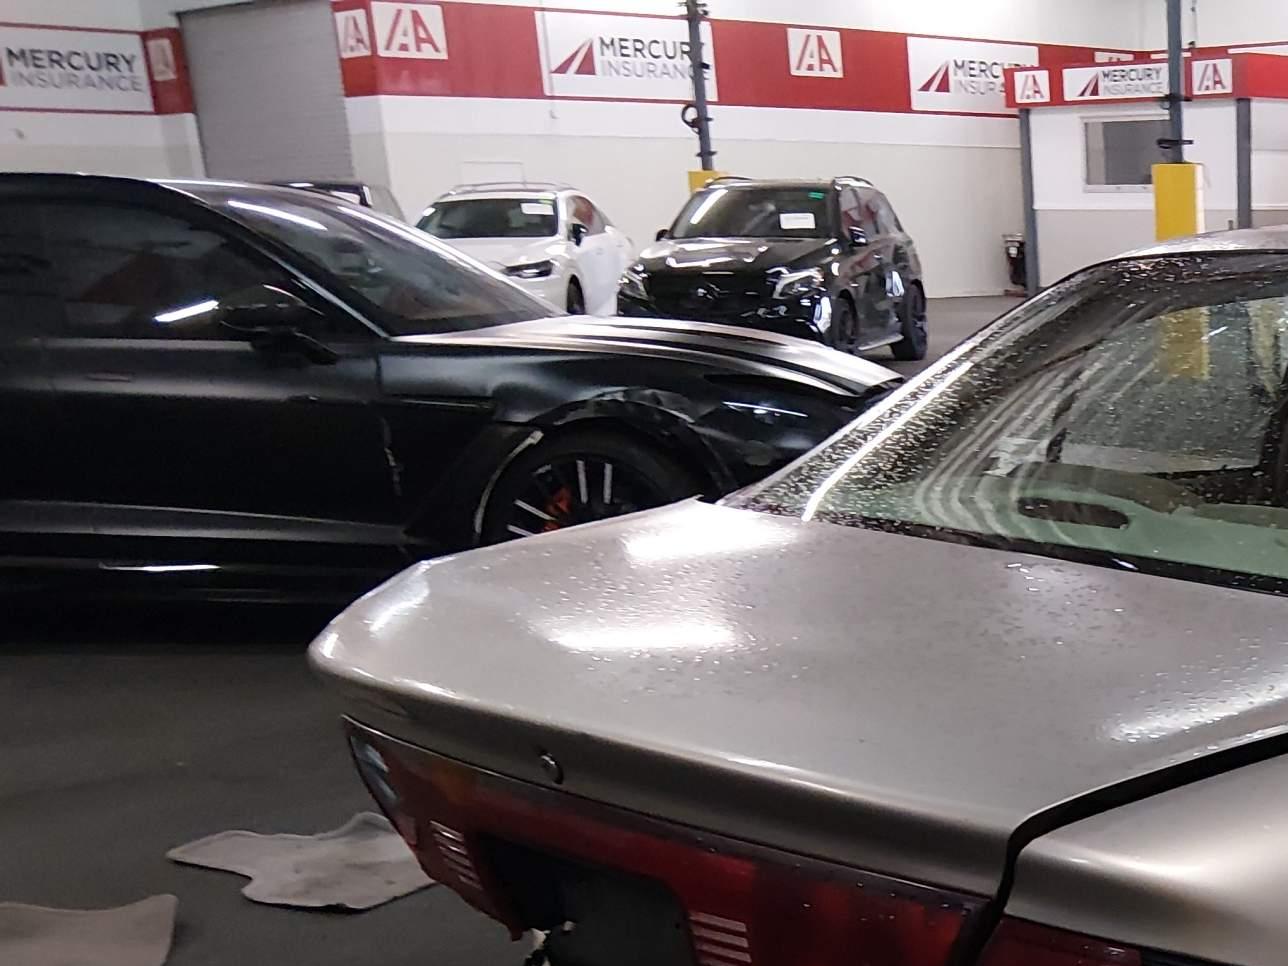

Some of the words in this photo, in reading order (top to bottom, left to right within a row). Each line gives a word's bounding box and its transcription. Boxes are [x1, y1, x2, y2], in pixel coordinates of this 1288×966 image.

[598, 35, 703, 60] MERCUR
[6, 47, 137, 73] MERCURY
[953, 59, 1015, 79] MERC
[9, 71, 145, 92] INSURANCE
[1102, 67, 1161, 82] MERCURY
[1102, 82, 1164, 95] INSURANCE
